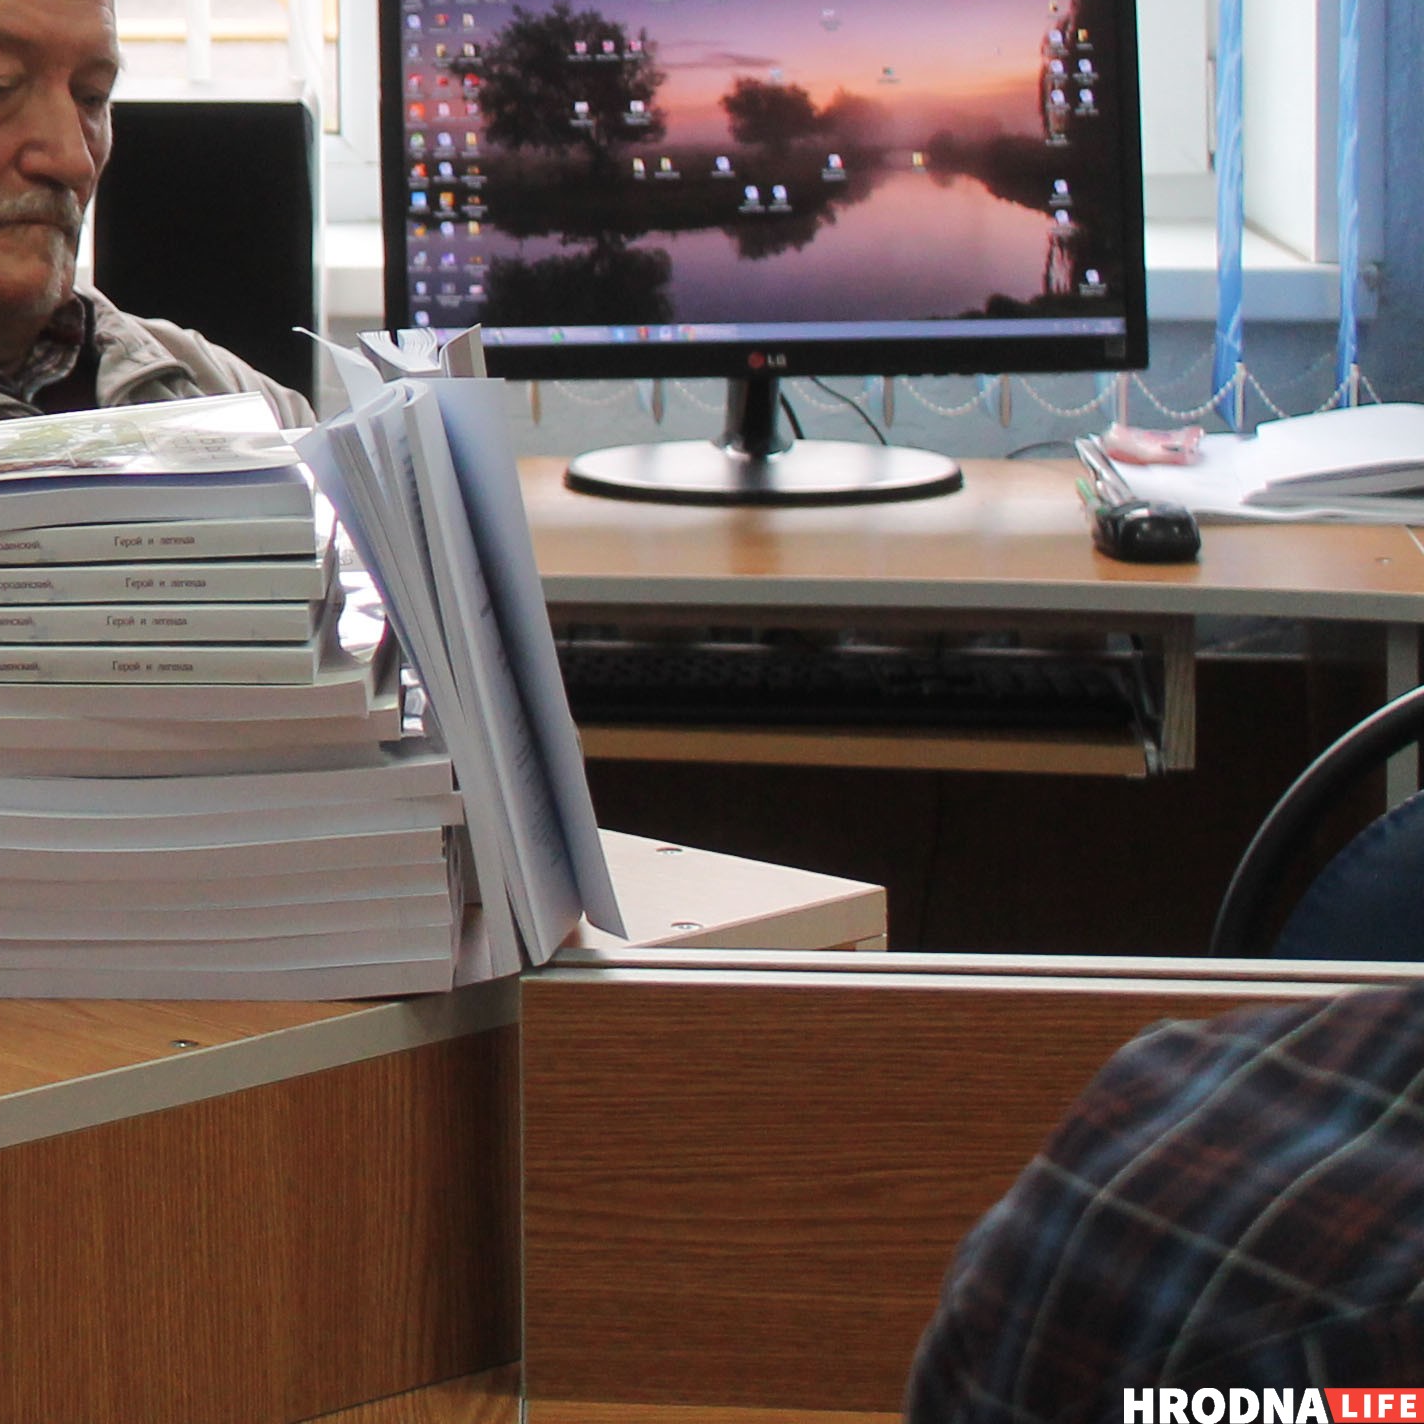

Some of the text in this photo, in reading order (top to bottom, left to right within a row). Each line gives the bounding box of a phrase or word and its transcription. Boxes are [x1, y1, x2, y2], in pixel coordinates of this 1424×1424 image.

[767, 353, 787, 367] LG
[114, 536, 142, 548] Герой
[160, 536, 195, 545] легенда
[125, 578, 153, 589] Герой
[170, 579, 206, 588] легенда
[106, 616, 134, 627] Герой
[152, 617, 187, 626] легенда
[112, 661, 140, 672] Герой
[157, 662, 193, 671] легенда
